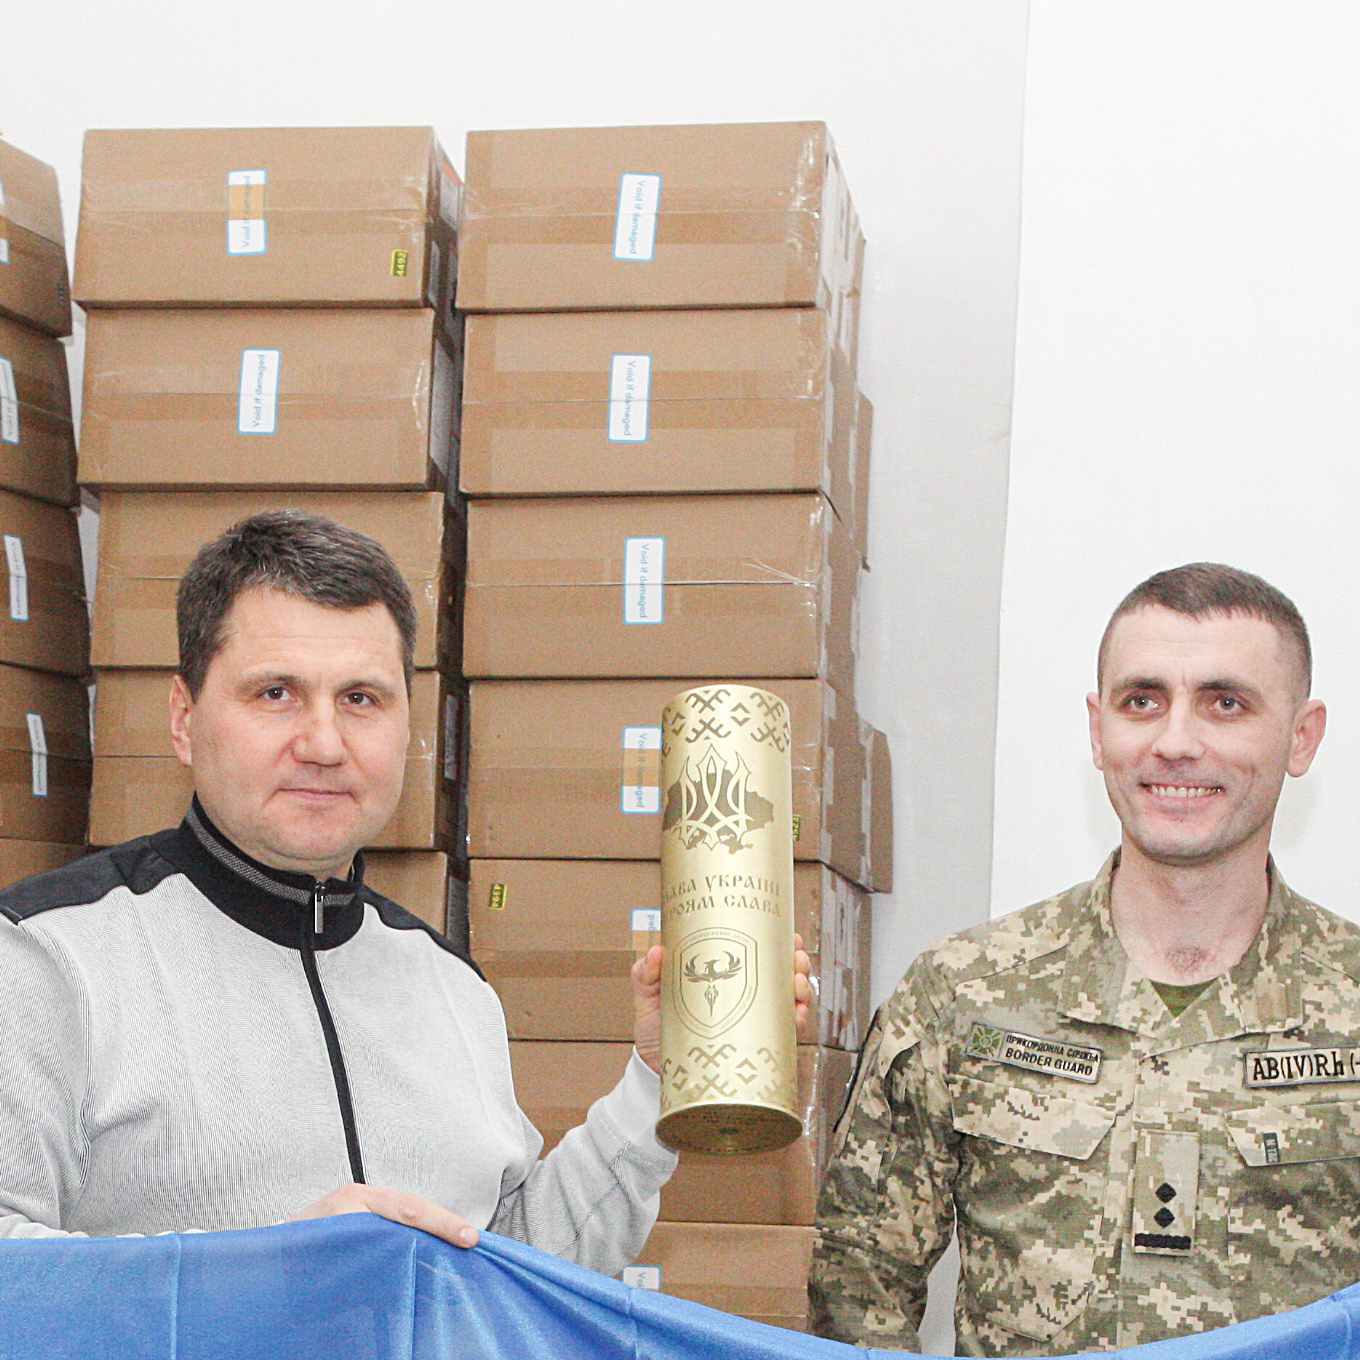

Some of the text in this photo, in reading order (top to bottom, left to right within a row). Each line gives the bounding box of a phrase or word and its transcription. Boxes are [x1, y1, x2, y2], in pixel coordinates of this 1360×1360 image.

[635, 180, 646, 200] Void
[628, 212, 641, 254] damaged
[255, 354, 266, 394] damaged
[621, 360, 636, 435] Void if damaged
[252, 406, 261, 427] Void
[640, 543, 650, 565] Void
[638, 575, 648, 618] damaged
[724, 894, 781, 918] СЛАВА
[1005, 1047, 1093, 1076] BORDER GUARD
[1253, 1050, 1344, 1081] AB(IV)Rh
